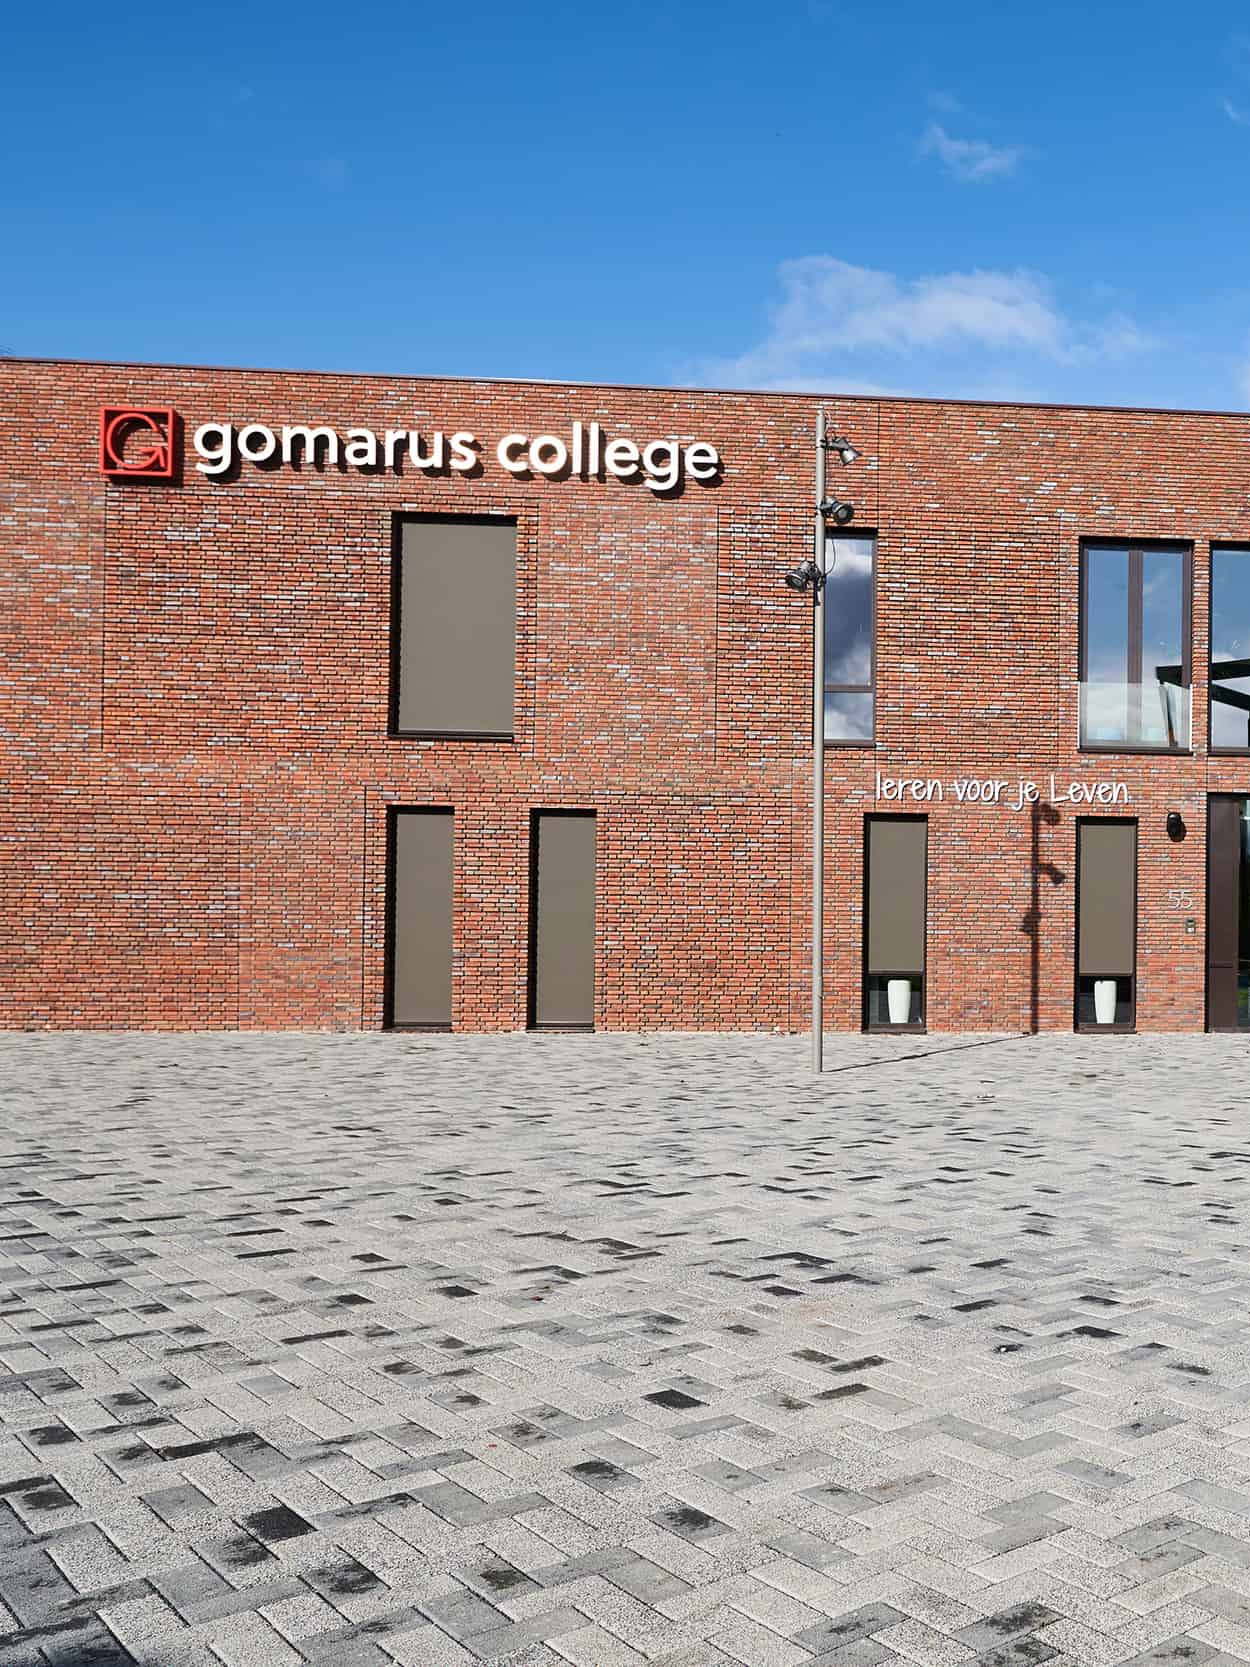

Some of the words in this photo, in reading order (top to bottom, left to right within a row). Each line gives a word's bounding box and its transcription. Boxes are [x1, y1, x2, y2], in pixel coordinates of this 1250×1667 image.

[193, 422, 477, 475] gomarus
[497, 421, 719, 491] college
[875, 771, 943, 802] leren
[953, 777, 1008, 802] voor
[1010, 776, 1039, 811] je
[1050, 774, 1129, 804] Leven
